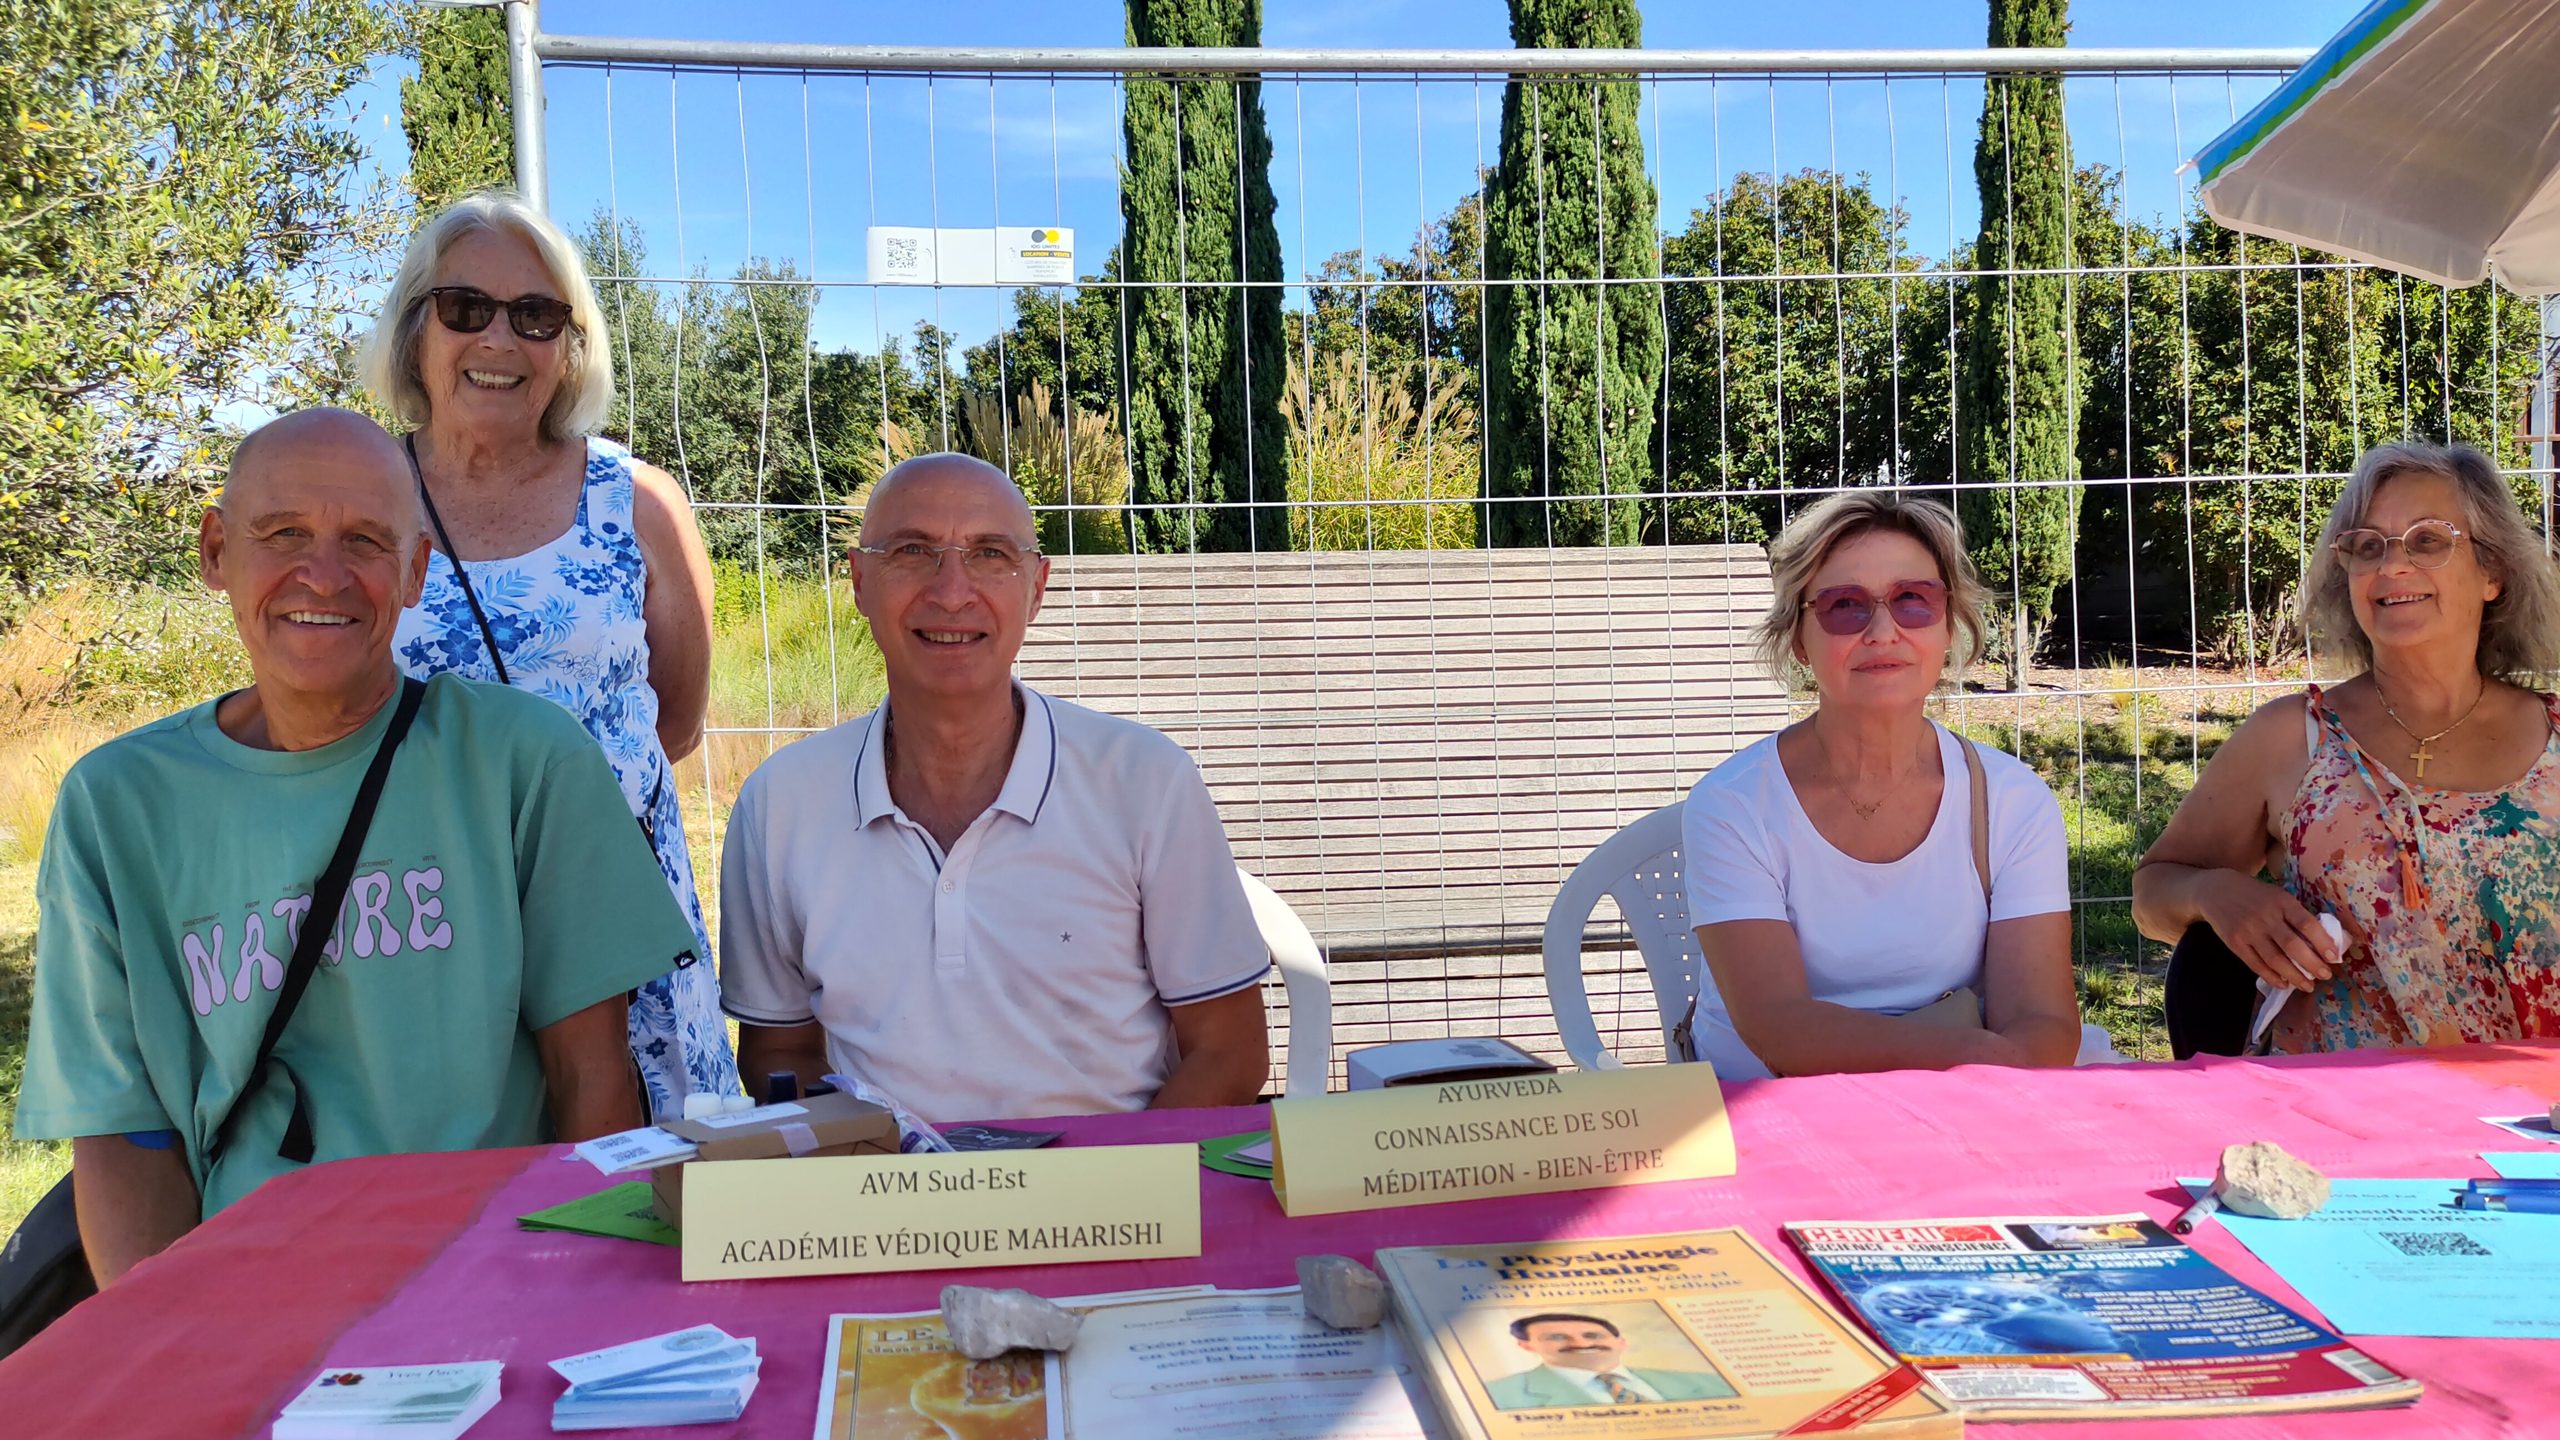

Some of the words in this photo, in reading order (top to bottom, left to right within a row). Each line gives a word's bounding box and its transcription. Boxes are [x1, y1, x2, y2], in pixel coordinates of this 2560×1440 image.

[1437, 1077, 1563, 1104] AYURVEDA
[1374, 1115, 1558, 1152] CONNAISSANCE
[1564, 1112, 1597, 1134] DE
[1601, 1108, 1640, 1130] SOI
[860, 1171, 920, 1195] AVM
[928, 1168, 1028, 1193] Sud-Est
[1363, 1164, 1517, 1197] MÉDITATION
[1537, 1148, 1665, 1181] BIEN-ÊTRE
[721, 1232, 868, 1264] ACADÉMIE
[876, 1228, 998, 1258] VÉDIQUE
[1008, 1222, 1163, 1251] MAHARISHI
[1803, 1226, 1946, 1243] CERVEAU
[1815, 1242, 1885, 1252] SCIENCE
[1906, 1241, 2016, 1252] CONSCIENCE
[1437, 1258, 1489, 1270] La
[1501, 1245, 1719, 1268] Physiologie
[1496, 1262, 1681, 1281] Humaine
